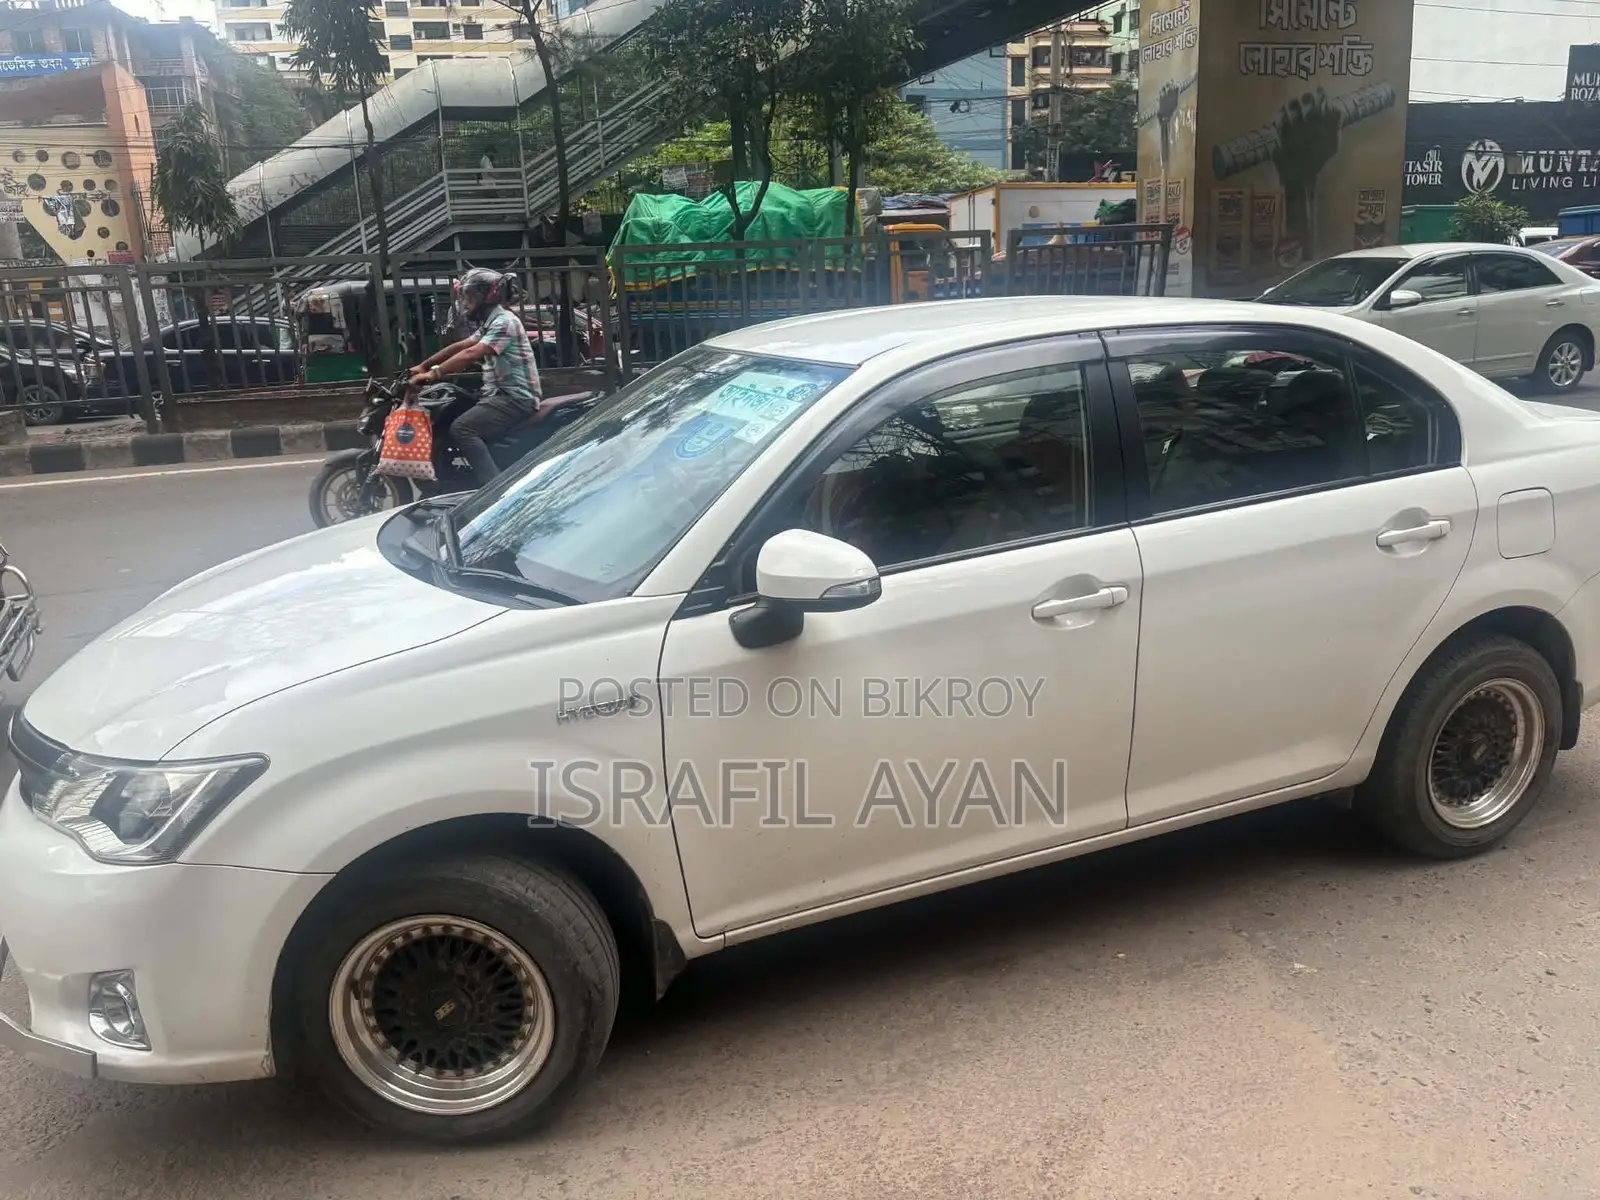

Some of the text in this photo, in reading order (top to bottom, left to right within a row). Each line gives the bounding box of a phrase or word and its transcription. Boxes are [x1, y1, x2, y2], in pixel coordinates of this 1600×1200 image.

[1403, 160, 1443, 173] TASIR
[1405, 173, 1443, 186] TOWER
[1512, 175, 1573, 190] LIVING
